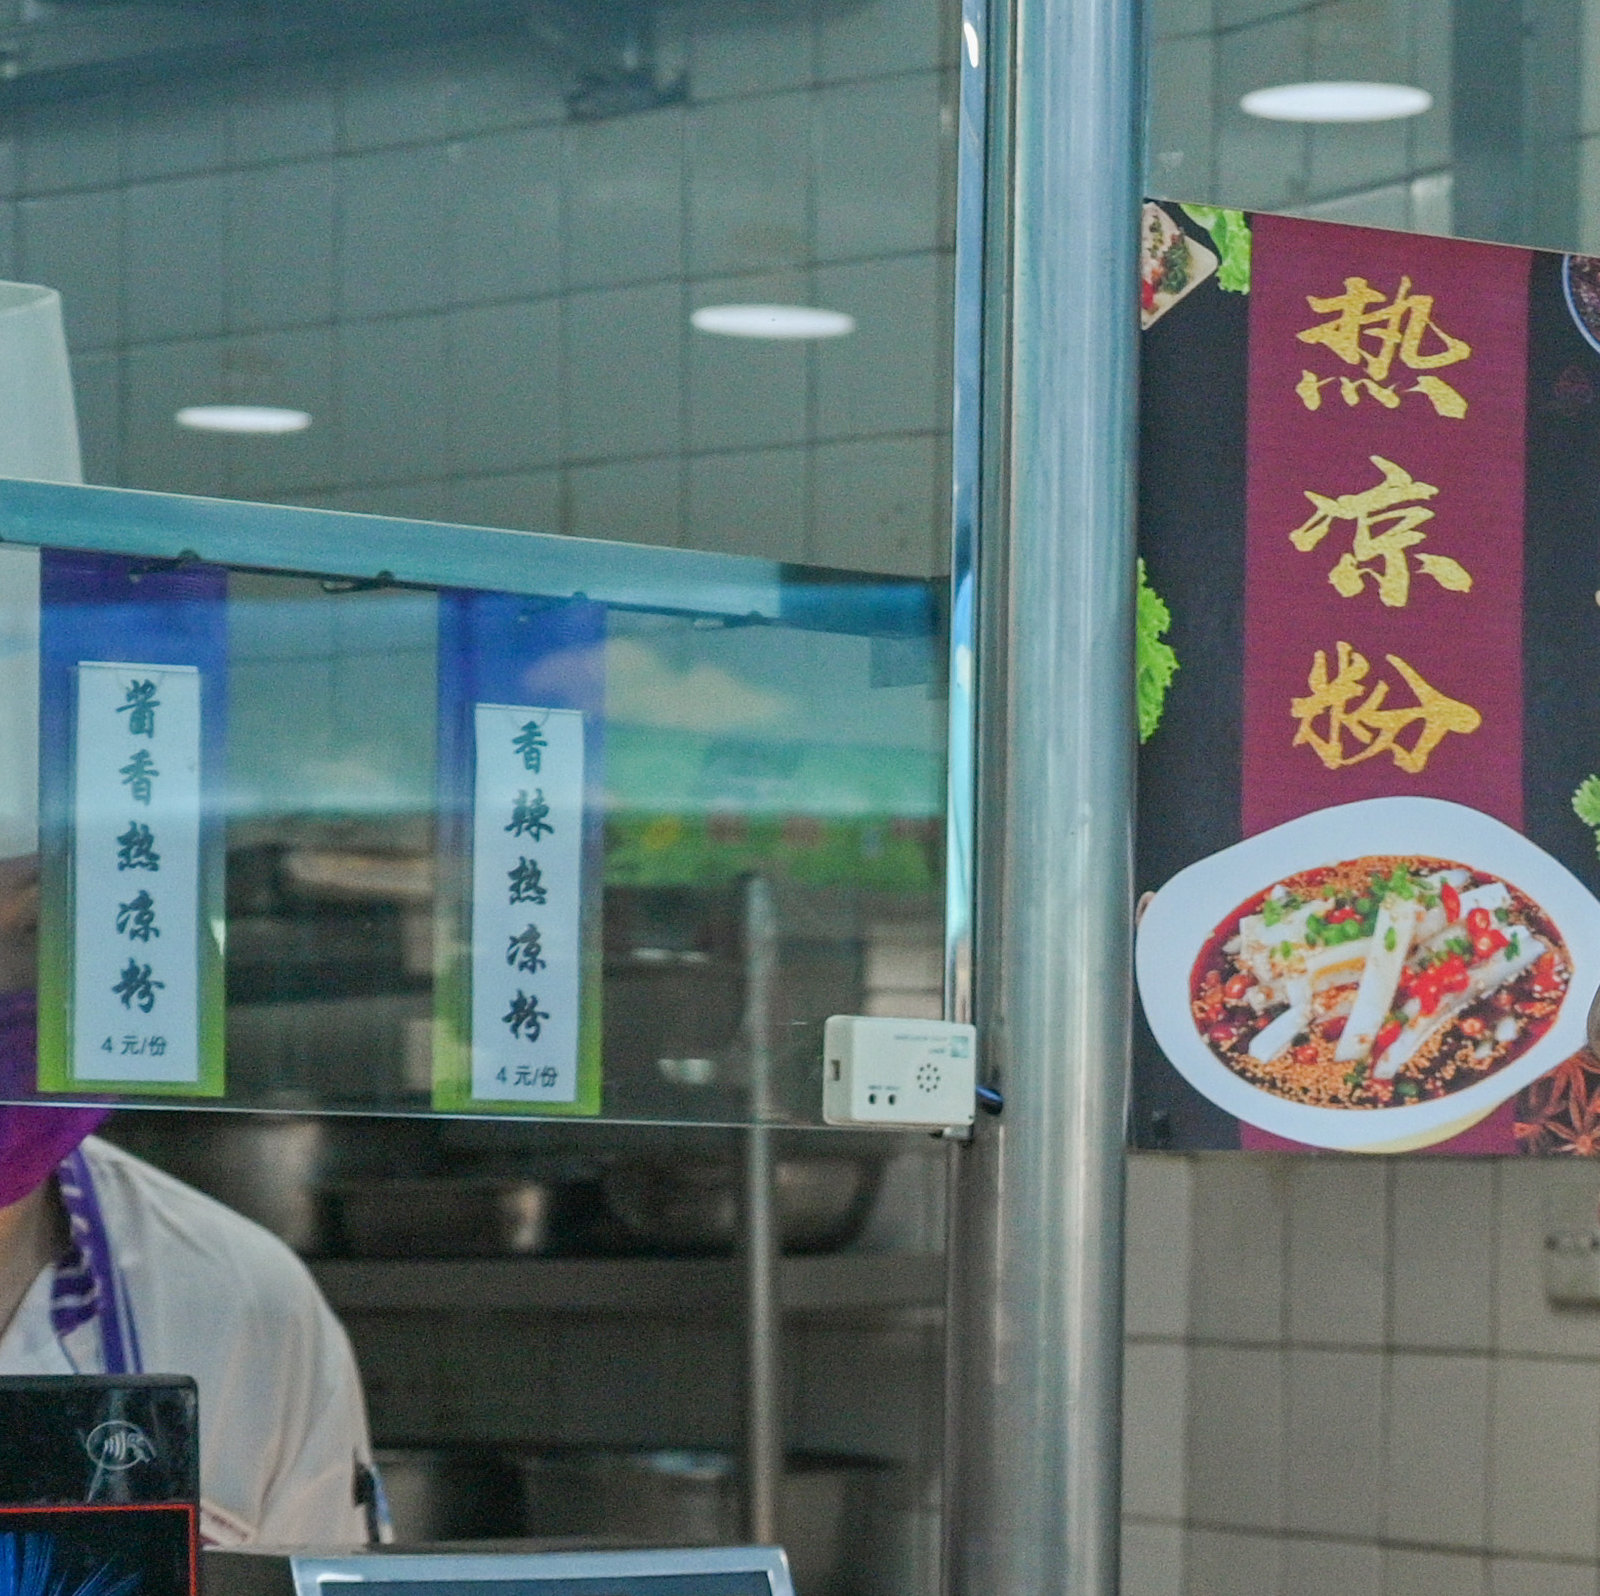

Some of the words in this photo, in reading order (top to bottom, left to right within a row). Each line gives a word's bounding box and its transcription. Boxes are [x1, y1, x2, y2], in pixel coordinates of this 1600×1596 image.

[1289, 276, 1482, 773] 热凉粉
[112, 679, 166, 1013] 酱香热凉粉
[502, 720, 555, 1043] 香辣热凉粉
